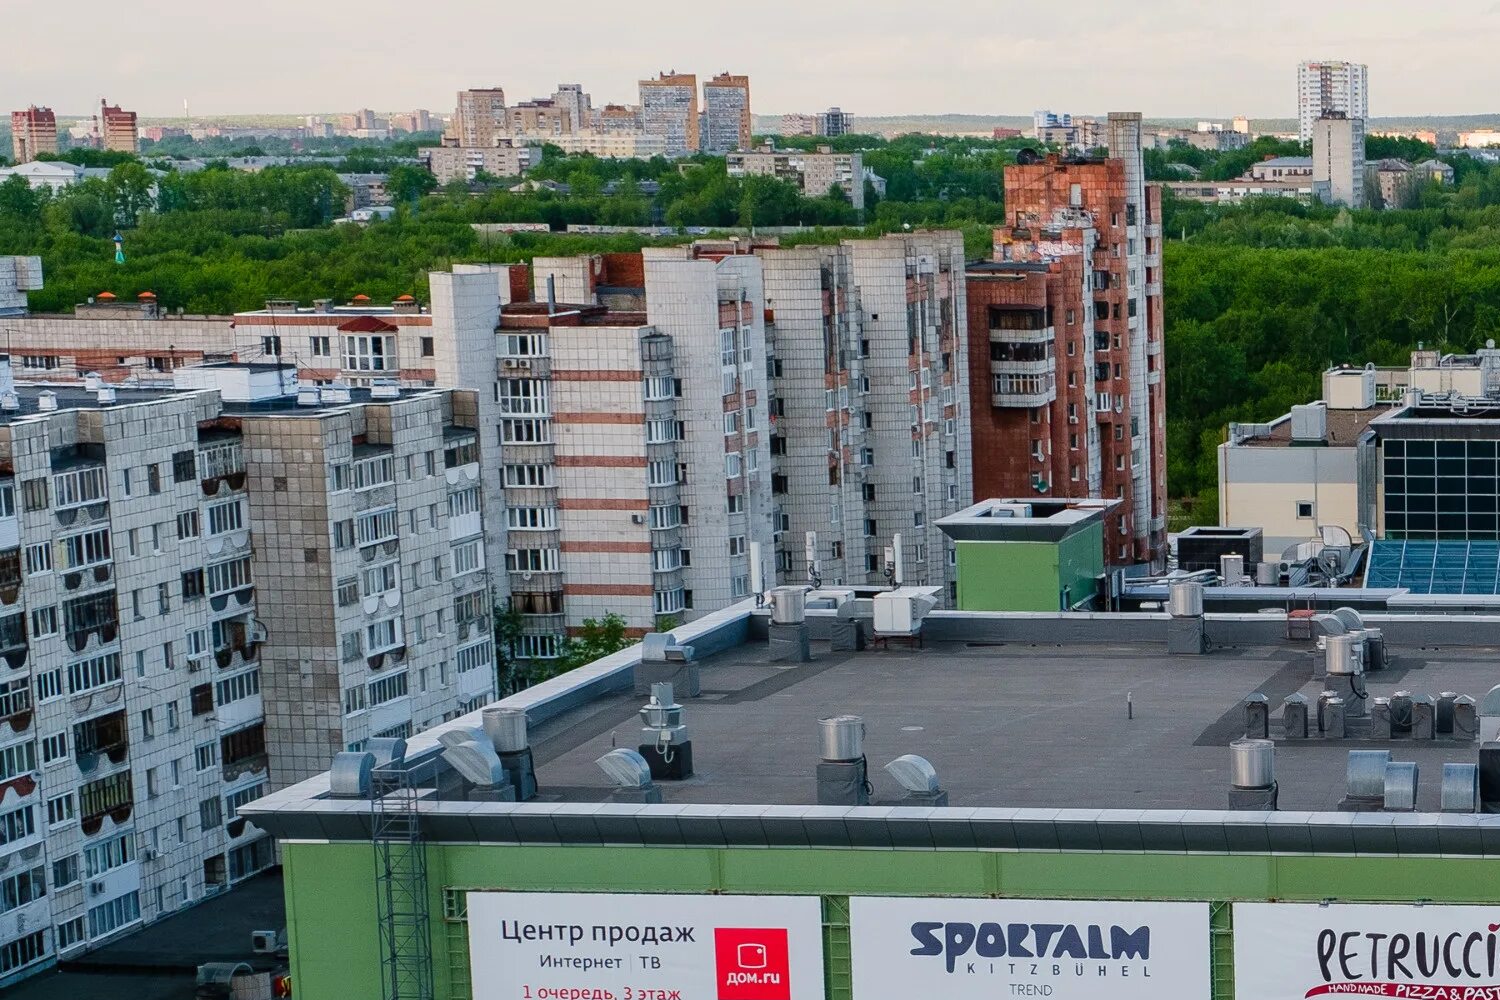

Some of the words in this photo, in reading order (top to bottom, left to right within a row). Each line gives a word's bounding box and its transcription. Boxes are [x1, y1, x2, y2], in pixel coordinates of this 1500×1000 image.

[501, 919, 584, 946] Центр
[592, 922, 695, 946] продаж
[910, 921, 1150, 974] SPORTALM
[539, 954, 622, 972] Интернет
[639, 955, 661, 970] ТВ
[967, 962, 1151, 978] KITZBÜHEL
[523, 985, 531, 999] 1
[623, 987, 632, 1000] 3
[638, 988, 681, 1000] этаж
[1009, 983, 1053, 997] TREND
